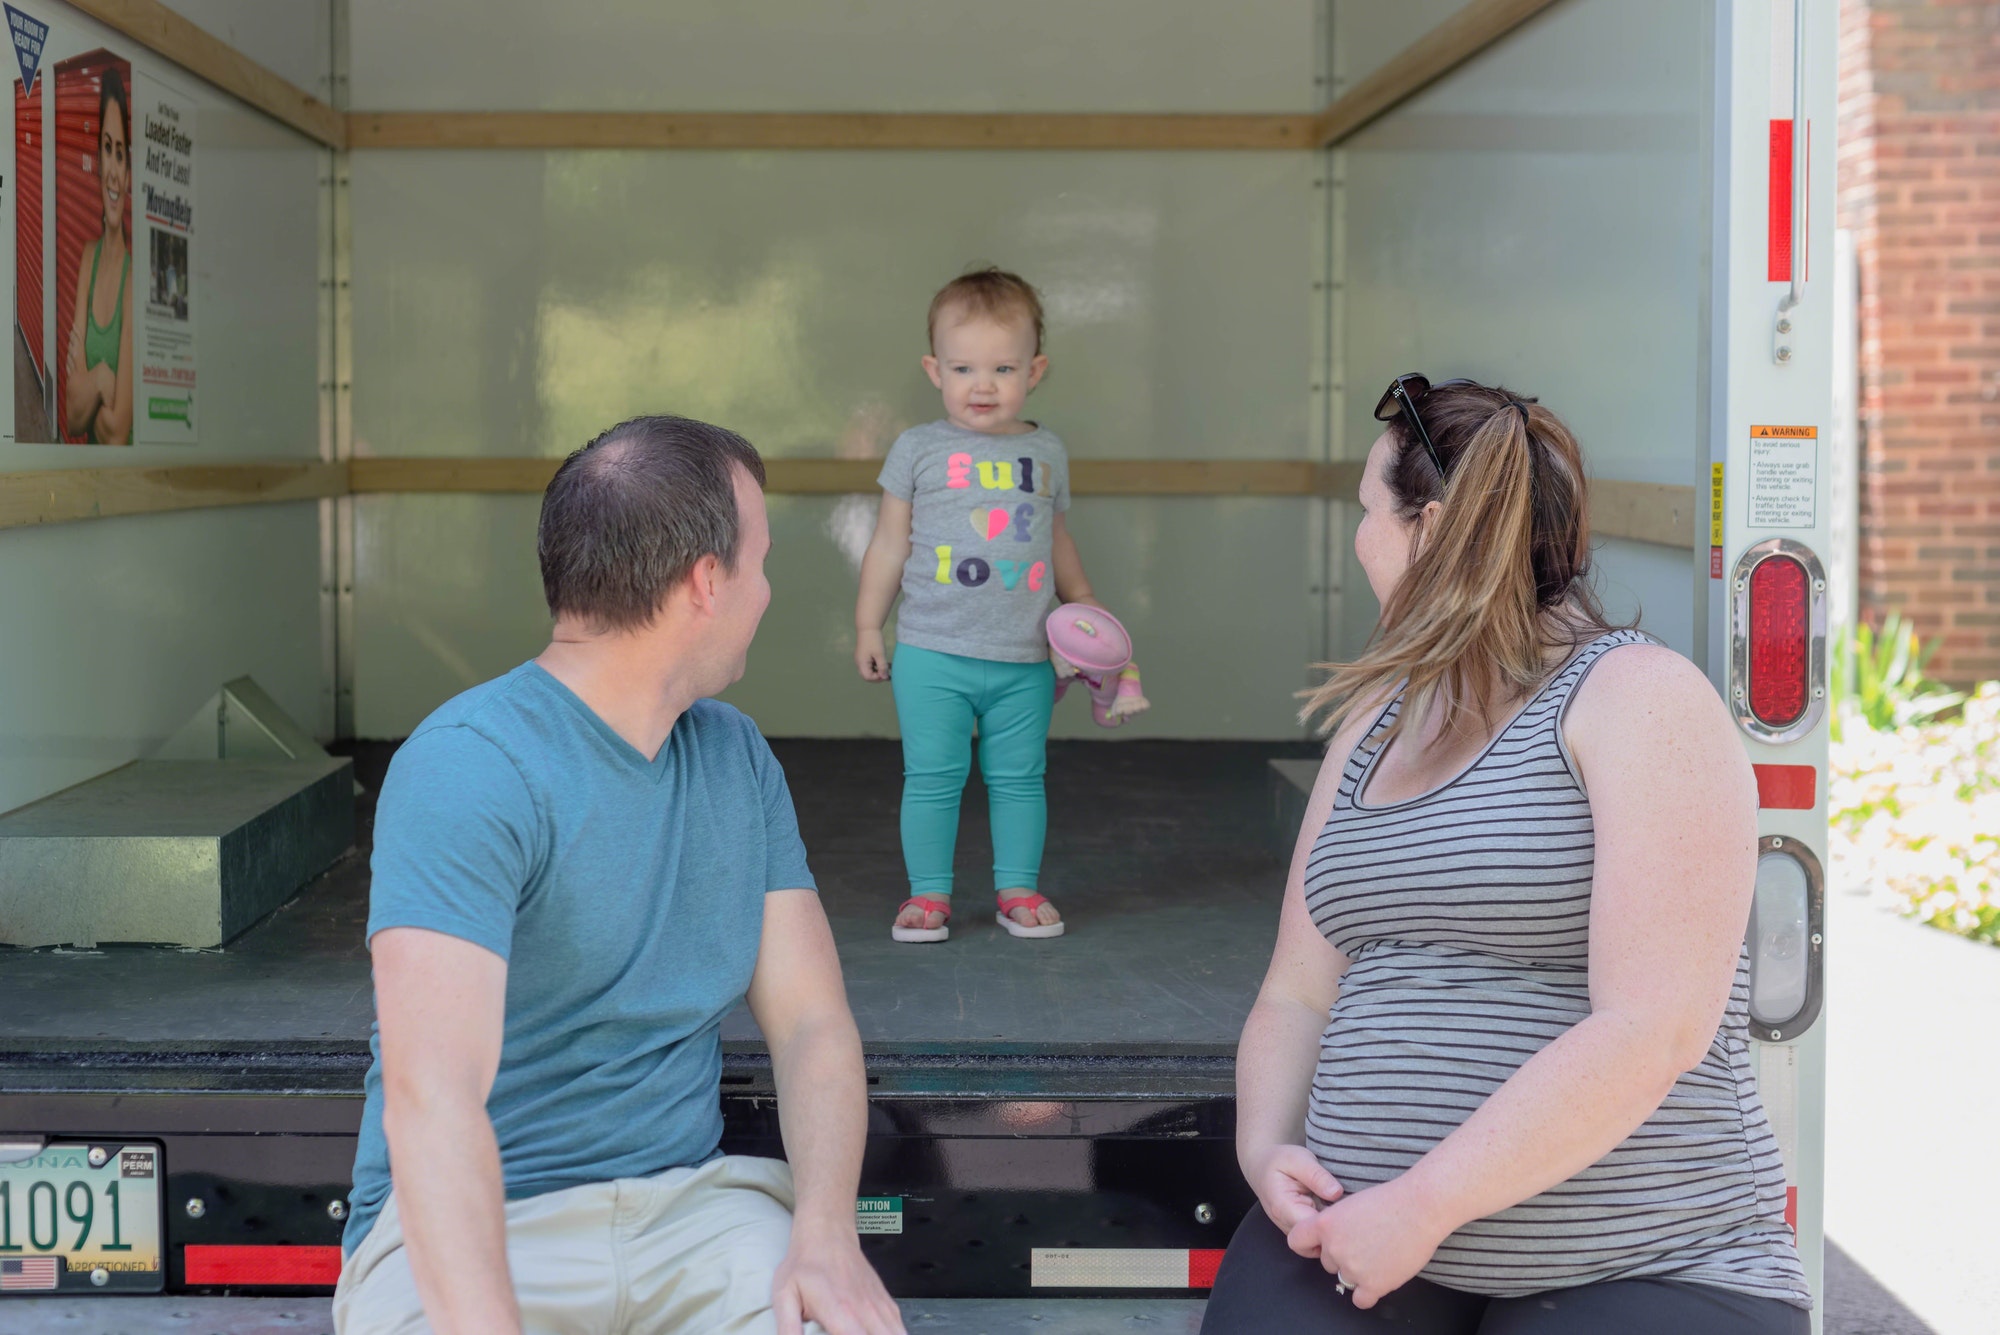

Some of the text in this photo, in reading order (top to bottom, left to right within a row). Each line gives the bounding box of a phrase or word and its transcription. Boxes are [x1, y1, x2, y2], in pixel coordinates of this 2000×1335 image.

[14, 31, 41, 56] READY FOR
[39, 27, 45, 41] IS
[145, 113, 192, 157] Loaded Faster
[145, 146, 160, 173] And
[161, 152, 173, 178] For
[1772, 428, 1810, 437] WARNING
[946, 452, 1052, 498] full
[935, 545, 1046, 592] love
[122, 1161, 153, 1171] PERM
[0, 1180, 132, 1252] 1091
